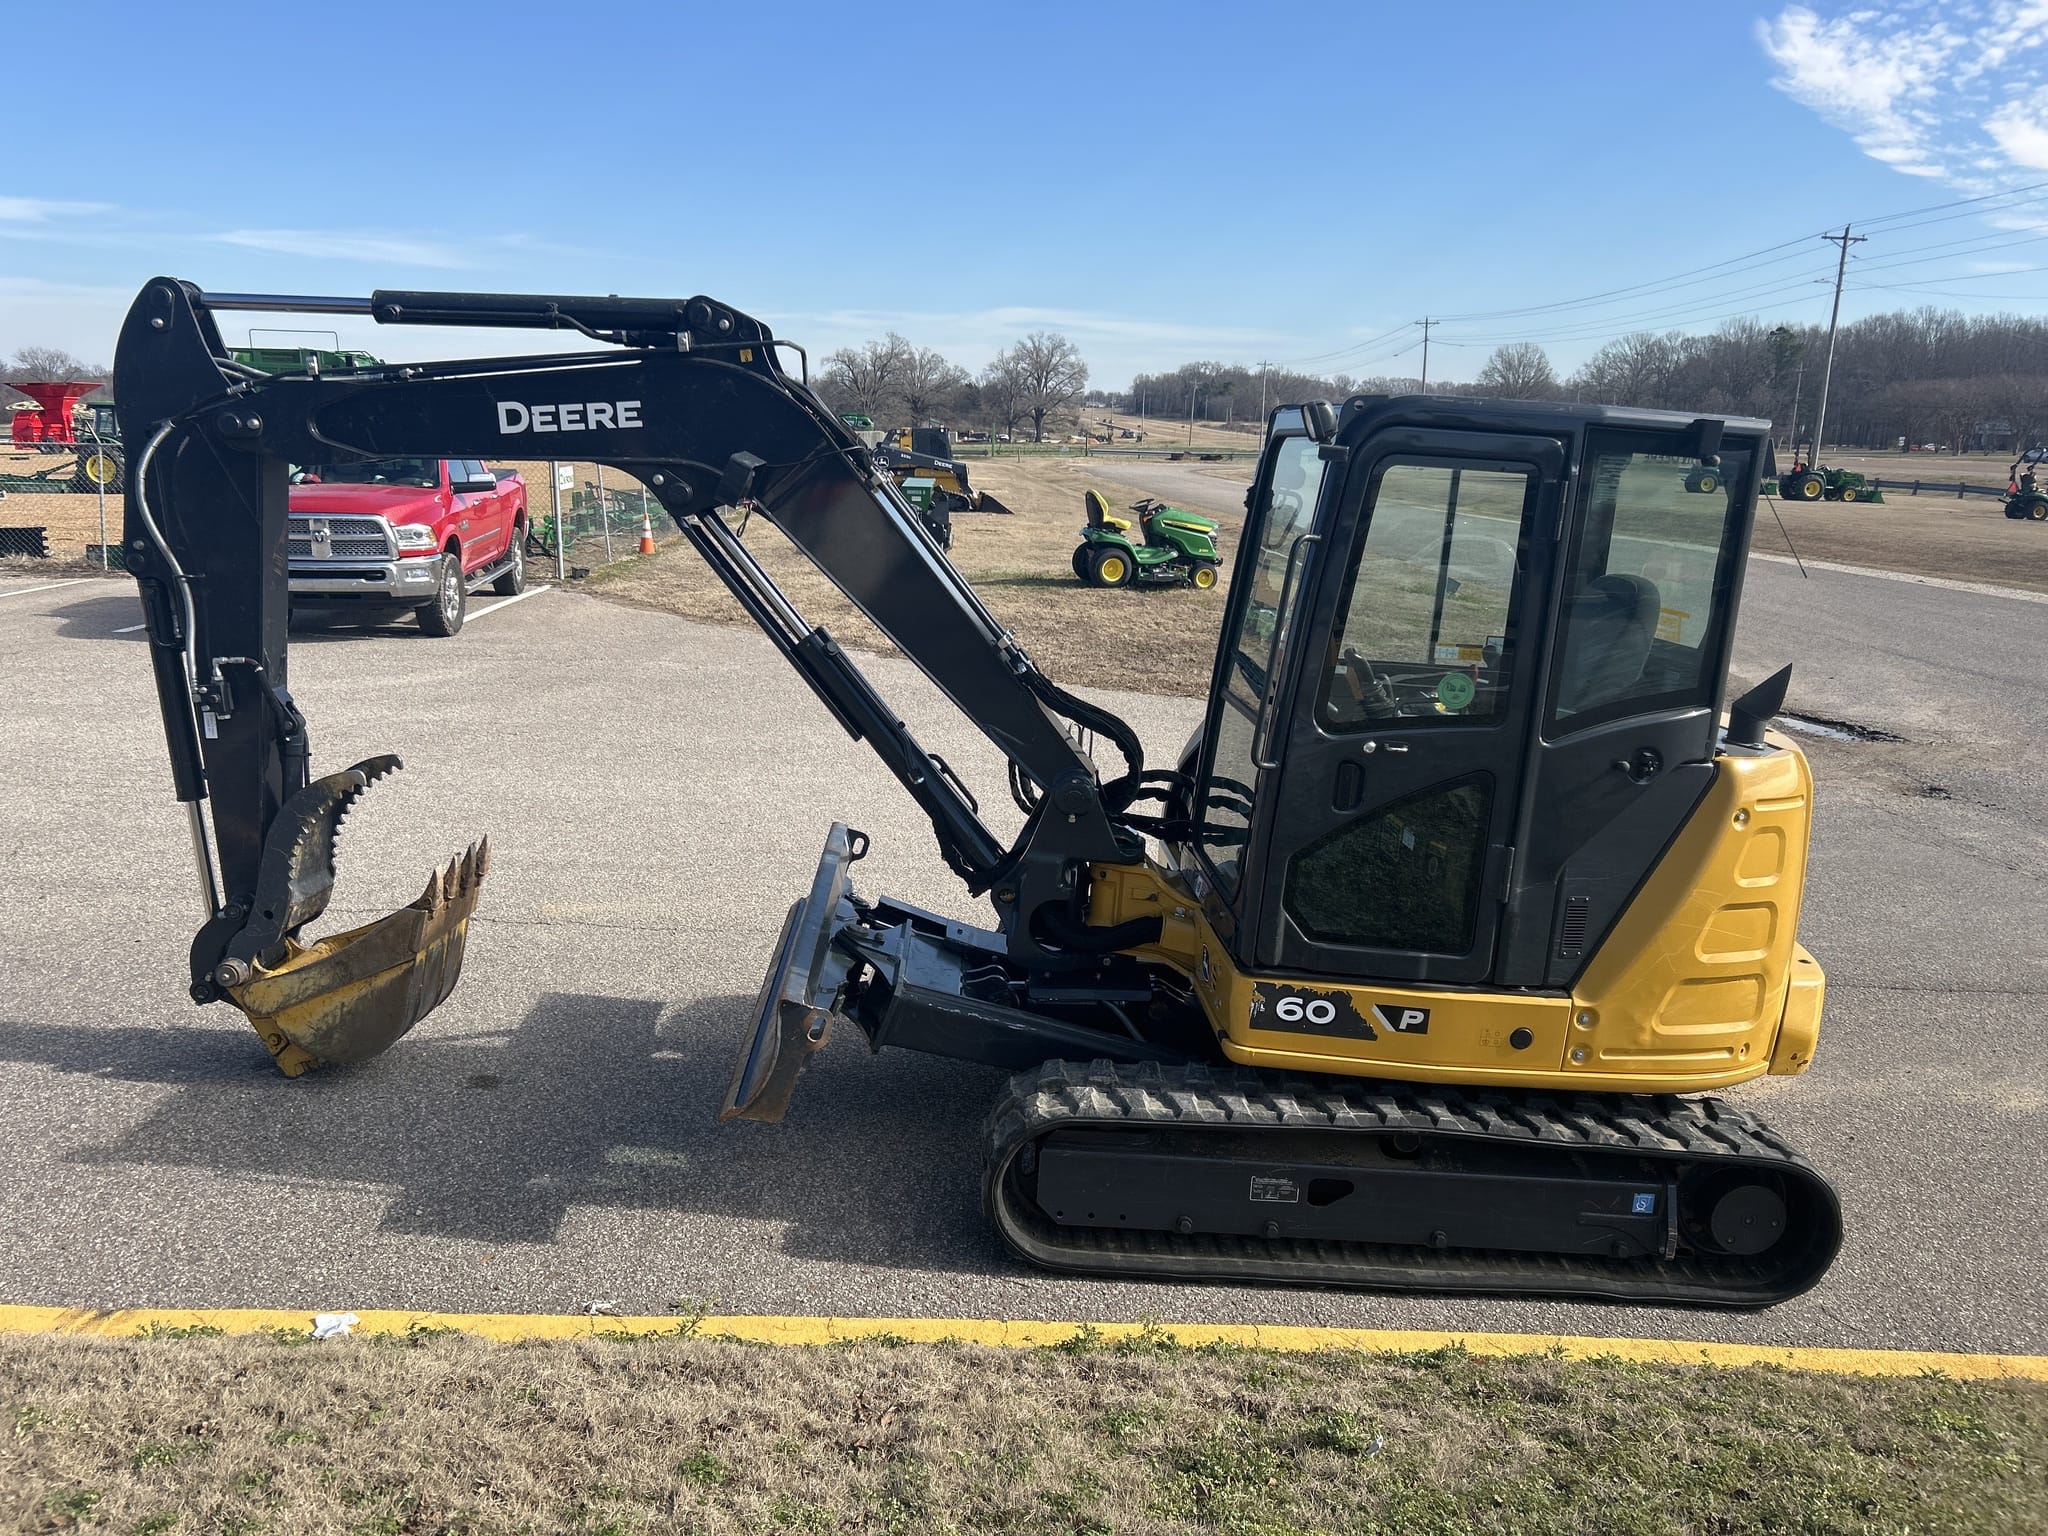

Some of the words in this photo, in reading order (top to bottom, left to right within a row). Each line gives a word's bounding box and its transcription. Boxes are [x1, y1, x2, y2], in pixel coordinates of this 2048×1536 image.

[497, 400, 643, 434] DEERE
[934, 459, 953, 469] DEERE
[1276, 997, 1336, 1025] 60
[1399, 1010, 1425, 1030] P
